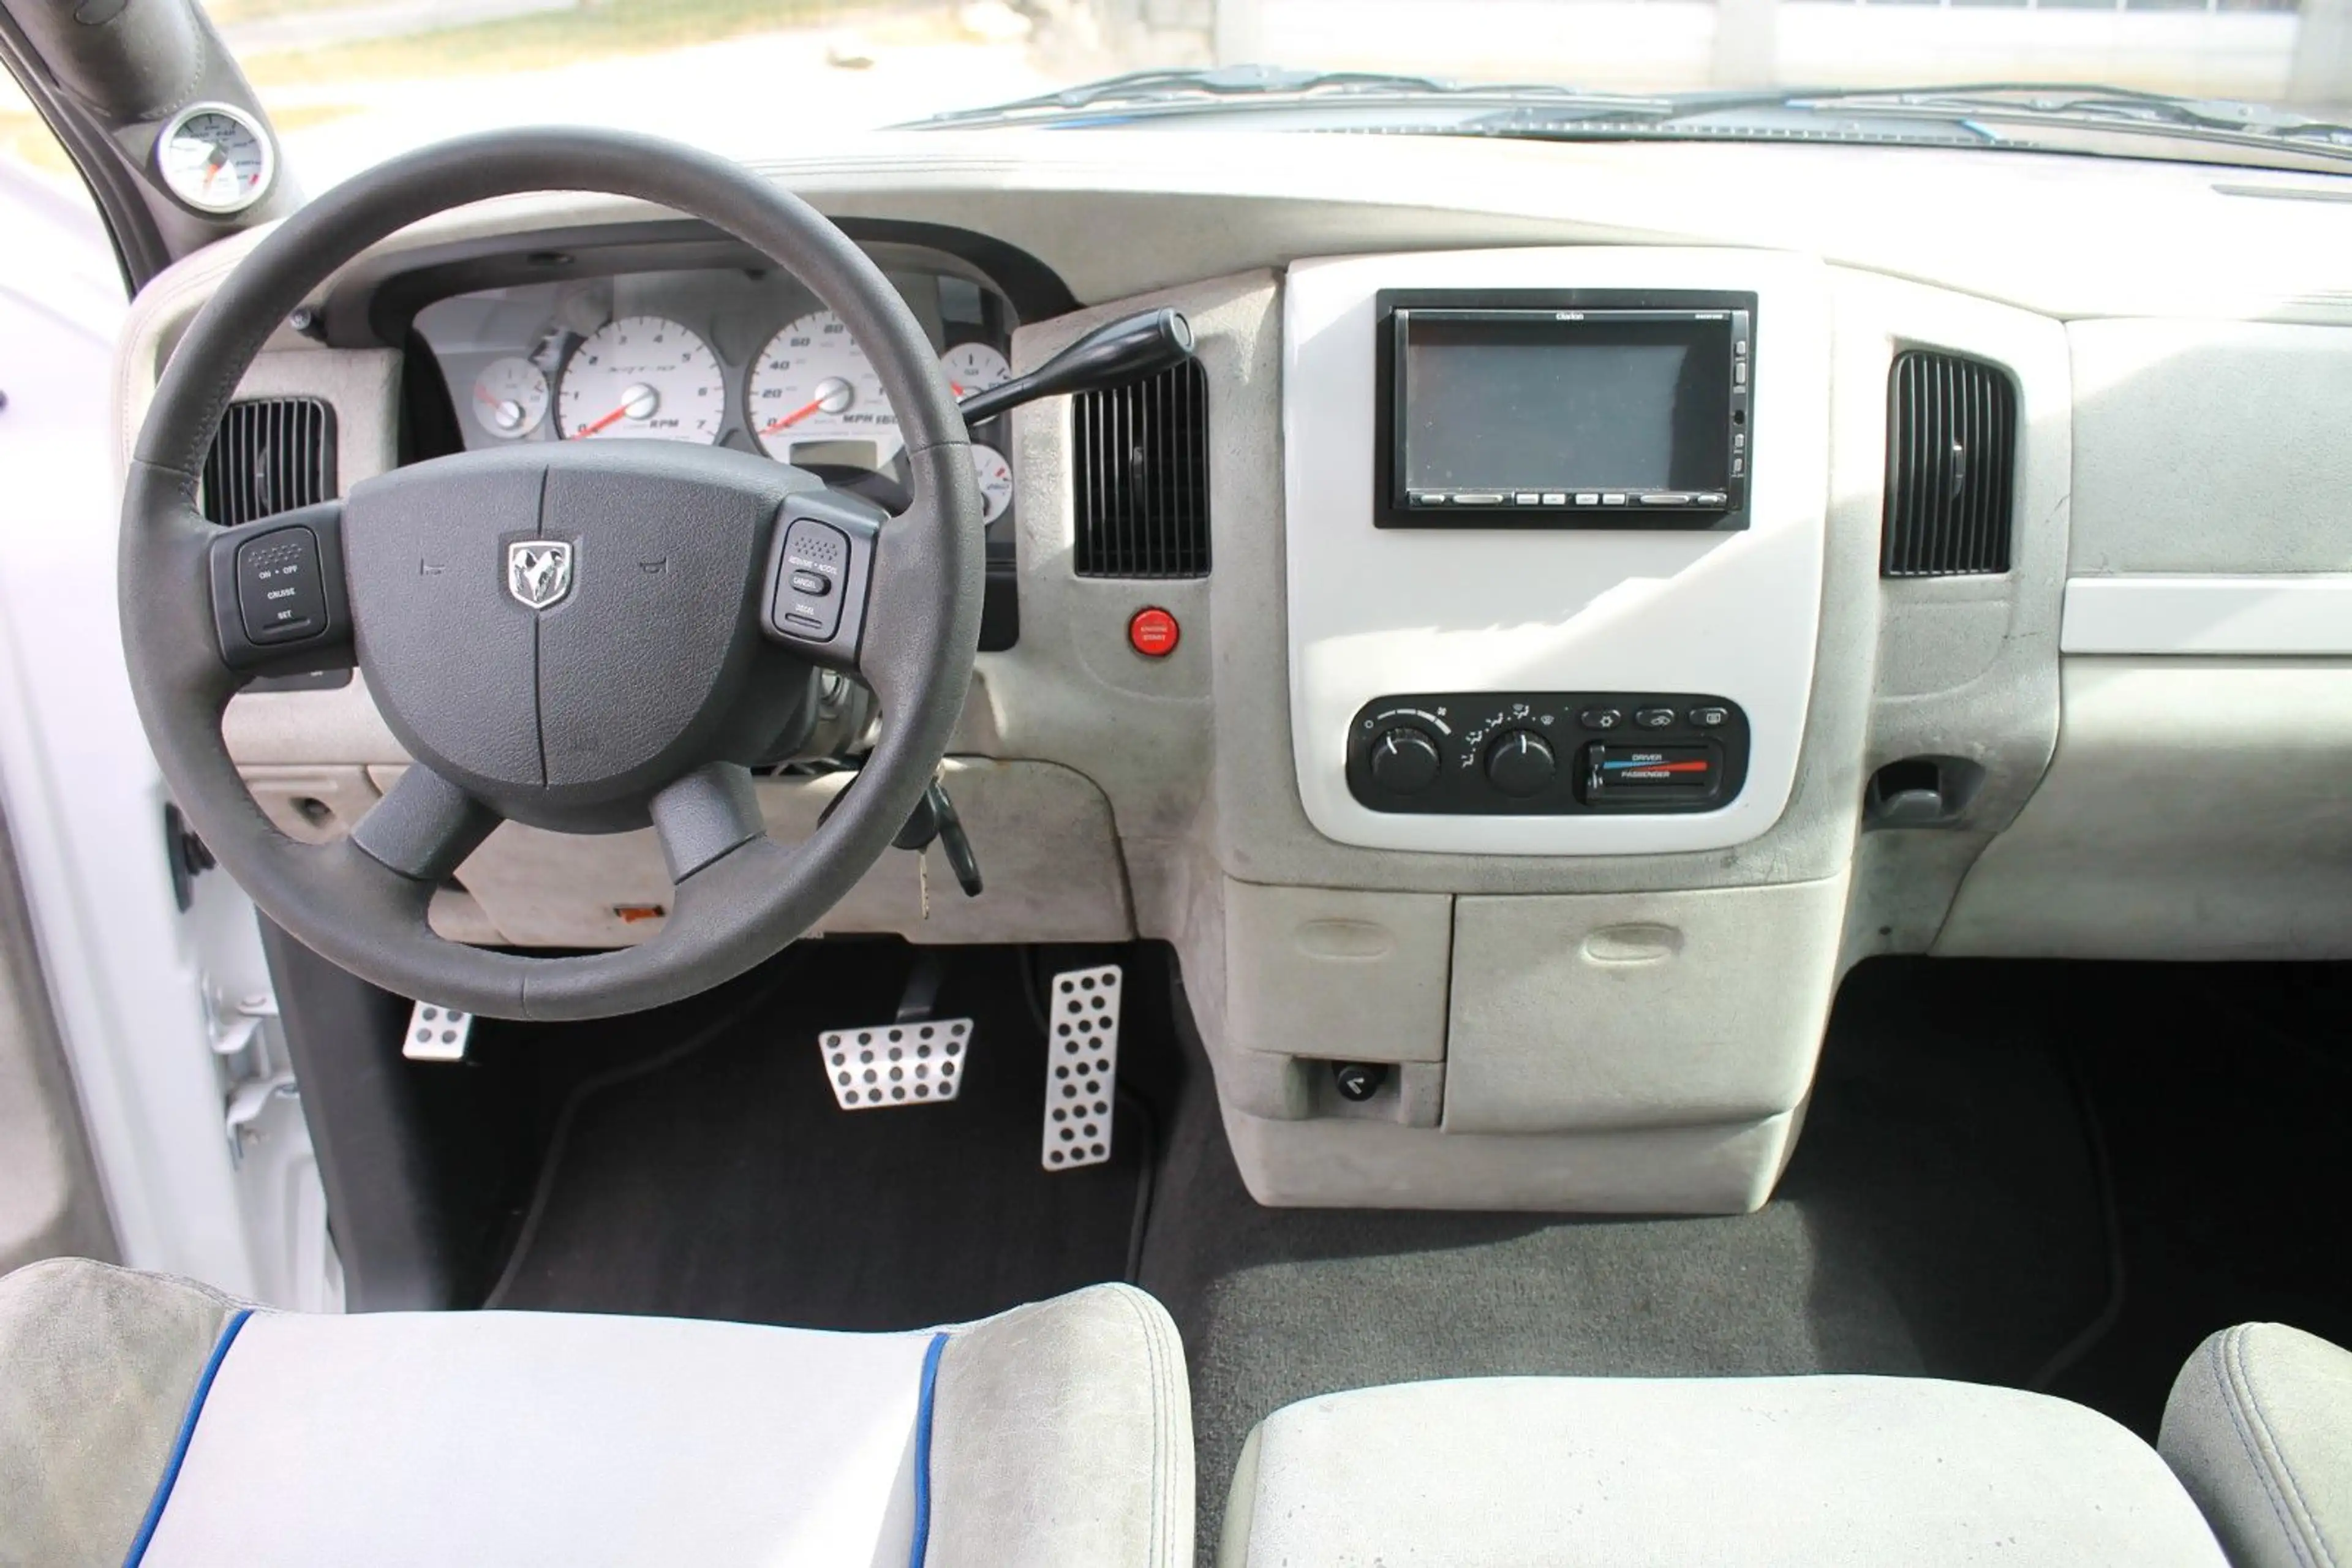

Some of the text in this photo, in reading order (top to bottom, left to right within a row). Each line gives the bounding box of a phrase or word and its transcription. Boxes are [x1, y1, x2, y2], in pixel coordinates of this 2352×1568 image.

[824, 324, 844, 334] 80
[653, 334, 663, 344] 4
[790, 337, 811, 347] 60
[682, 353, 692, 363] 5
[769, 360, 791, 370] 40
[761, 389, 783, 399] 20
[649, 419, 679, 428] RPM
[842, 414, 873, 423] MPH
[696, 420, 707, 429] 7
[258, 564, 298, 579] ON OFF
[267, 587, 296, 600] CRUISE
[277, 609, 292, 620] SET
